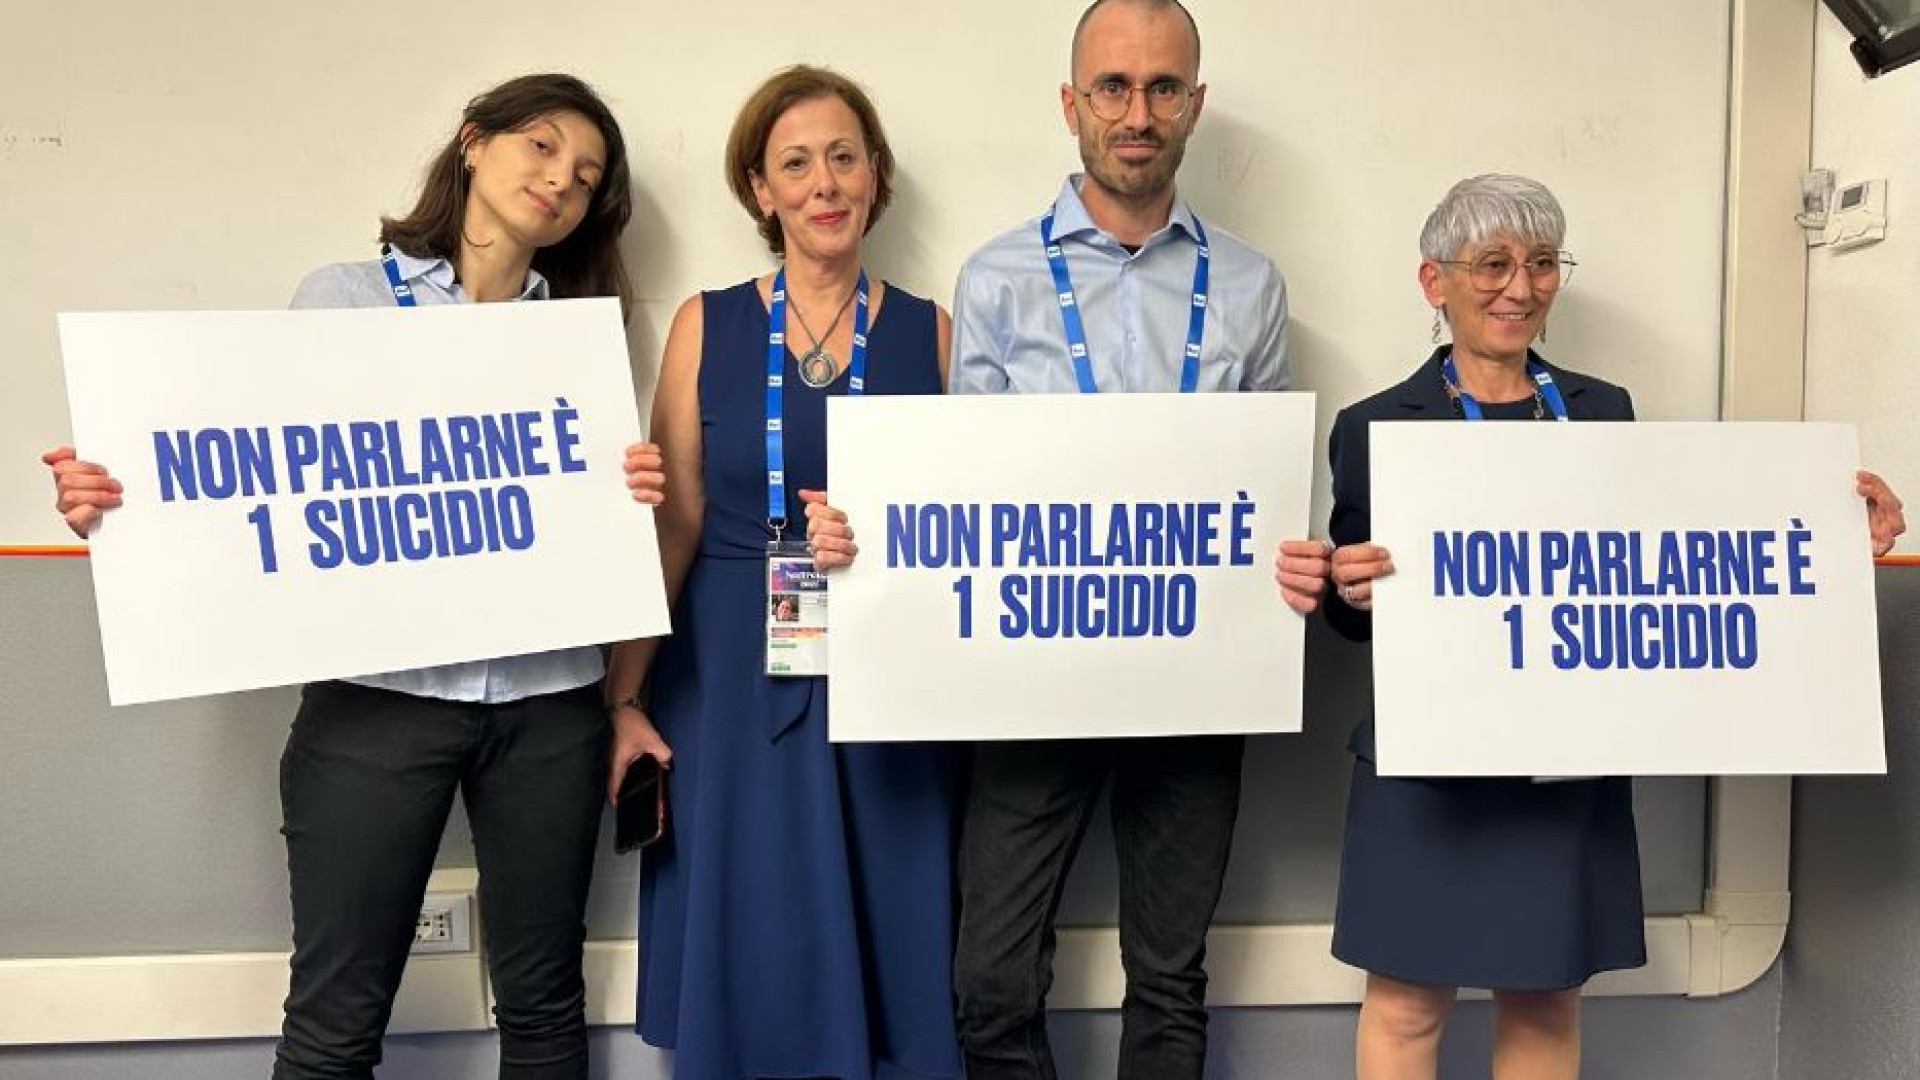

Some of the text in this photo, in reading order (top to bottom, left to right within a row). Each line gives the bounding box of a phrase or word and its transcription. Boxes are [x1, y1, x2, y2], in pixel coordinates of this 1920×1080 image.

[153, 395, 587, 502] NON PARLARNE È
[247, 485, 536, 573] 1 SUICIDIO
[886, 490, 1255, 569] NON PARLARNE È
[1433, 517, 1815, 598] NON PARLARNE È
[953, 573, 1197, 639] 1 SUICIDIO
[1503, 603, 1757, 670] 1 SUICIDIO
